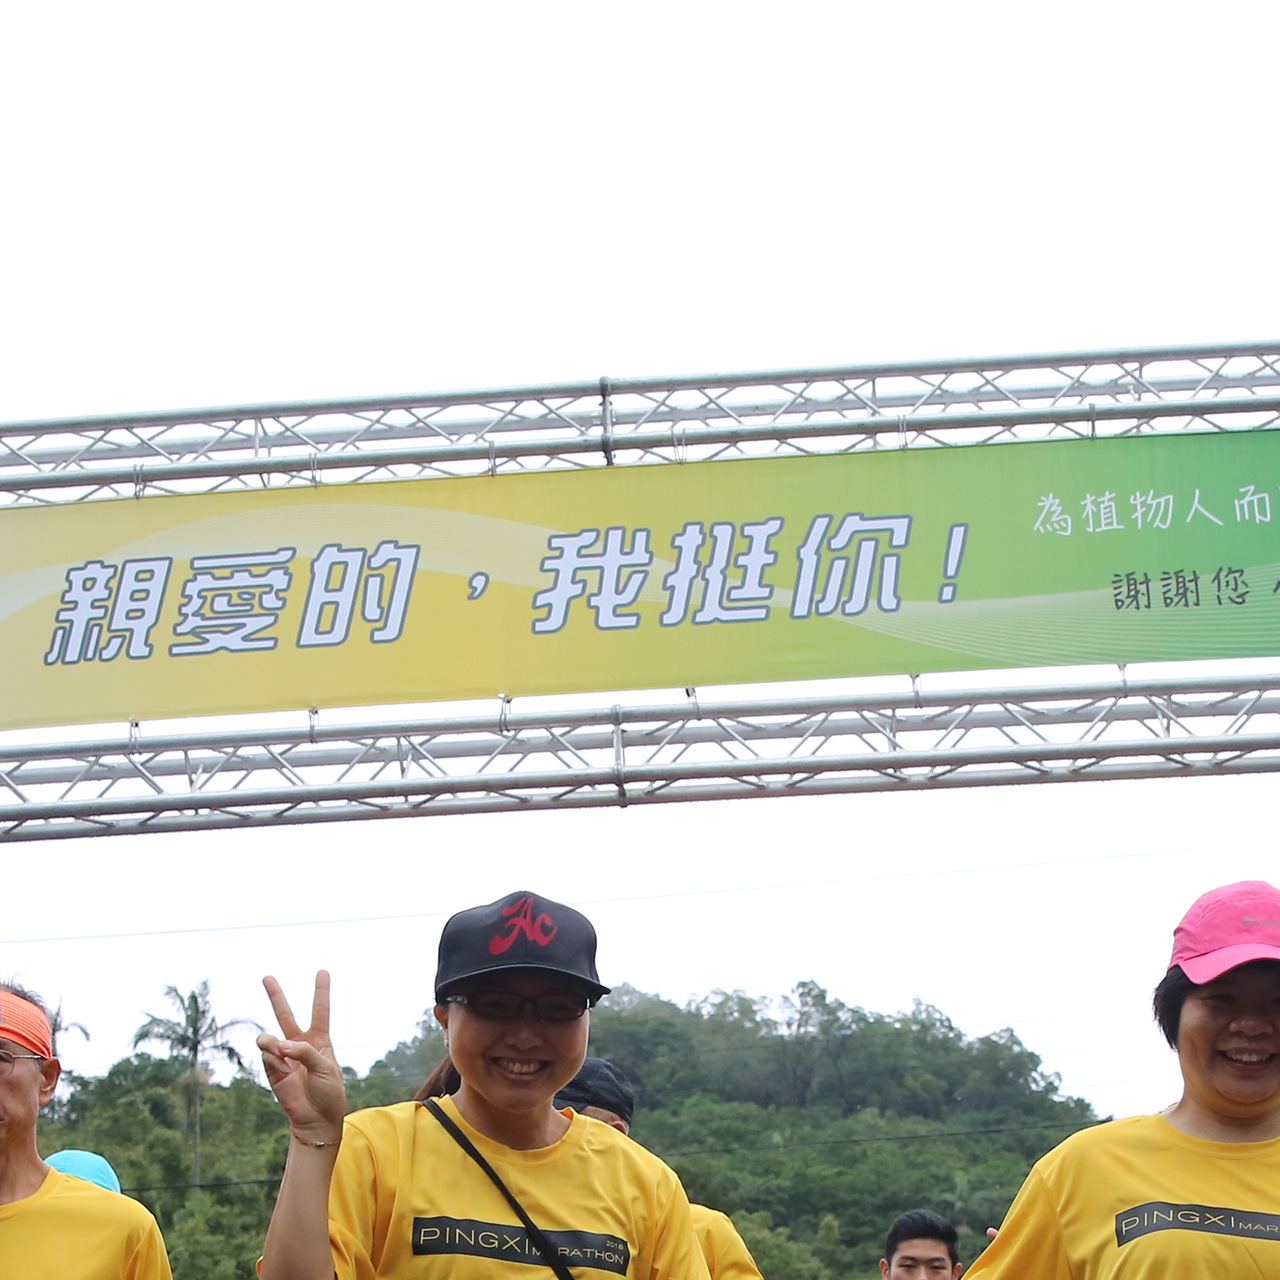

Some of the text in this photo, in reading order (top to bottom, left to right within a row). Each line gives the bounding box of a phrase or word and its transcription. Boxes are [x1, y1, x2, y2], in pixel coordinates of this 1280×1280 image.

[1122, 1209, 1235, 1235] PINGXI
[420, 1227, 624, 1265] PINGXI MRATHON
[606, 1240, 624, 1251] 2018
